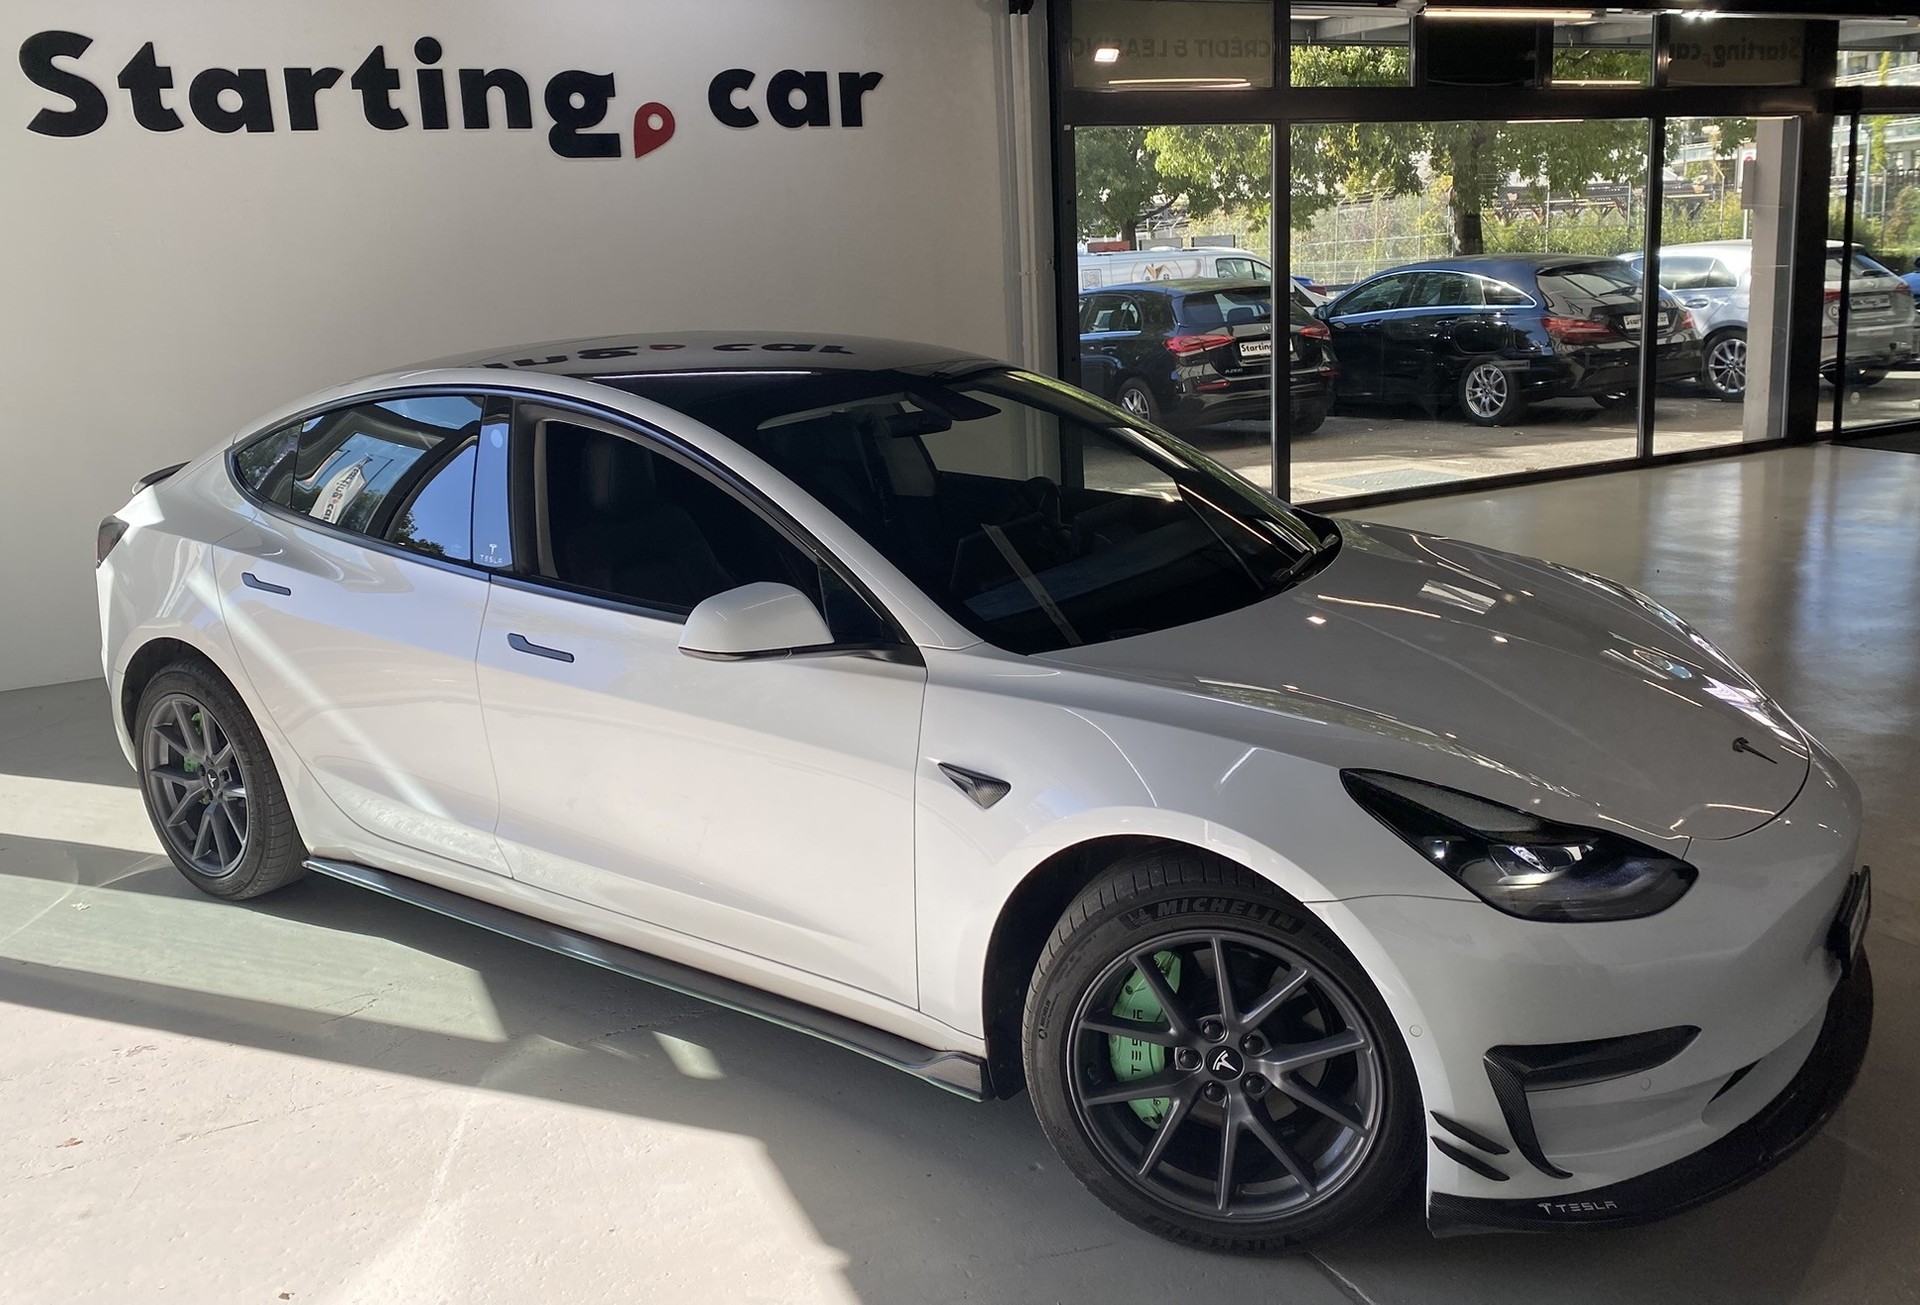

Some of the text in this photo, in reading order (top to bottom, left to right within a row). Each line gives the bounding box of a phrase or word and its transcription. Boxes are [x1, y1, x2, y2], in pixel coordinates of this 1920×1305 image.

[18, 30, 885, 158] Starting car
[1241, 343, 1272, 353] Startin
[480, 554, 503, 565] TESLA
[1156, 897, 1297, 931] MICHELIN
[1555, 1200, 1618, 1213] TESLA
